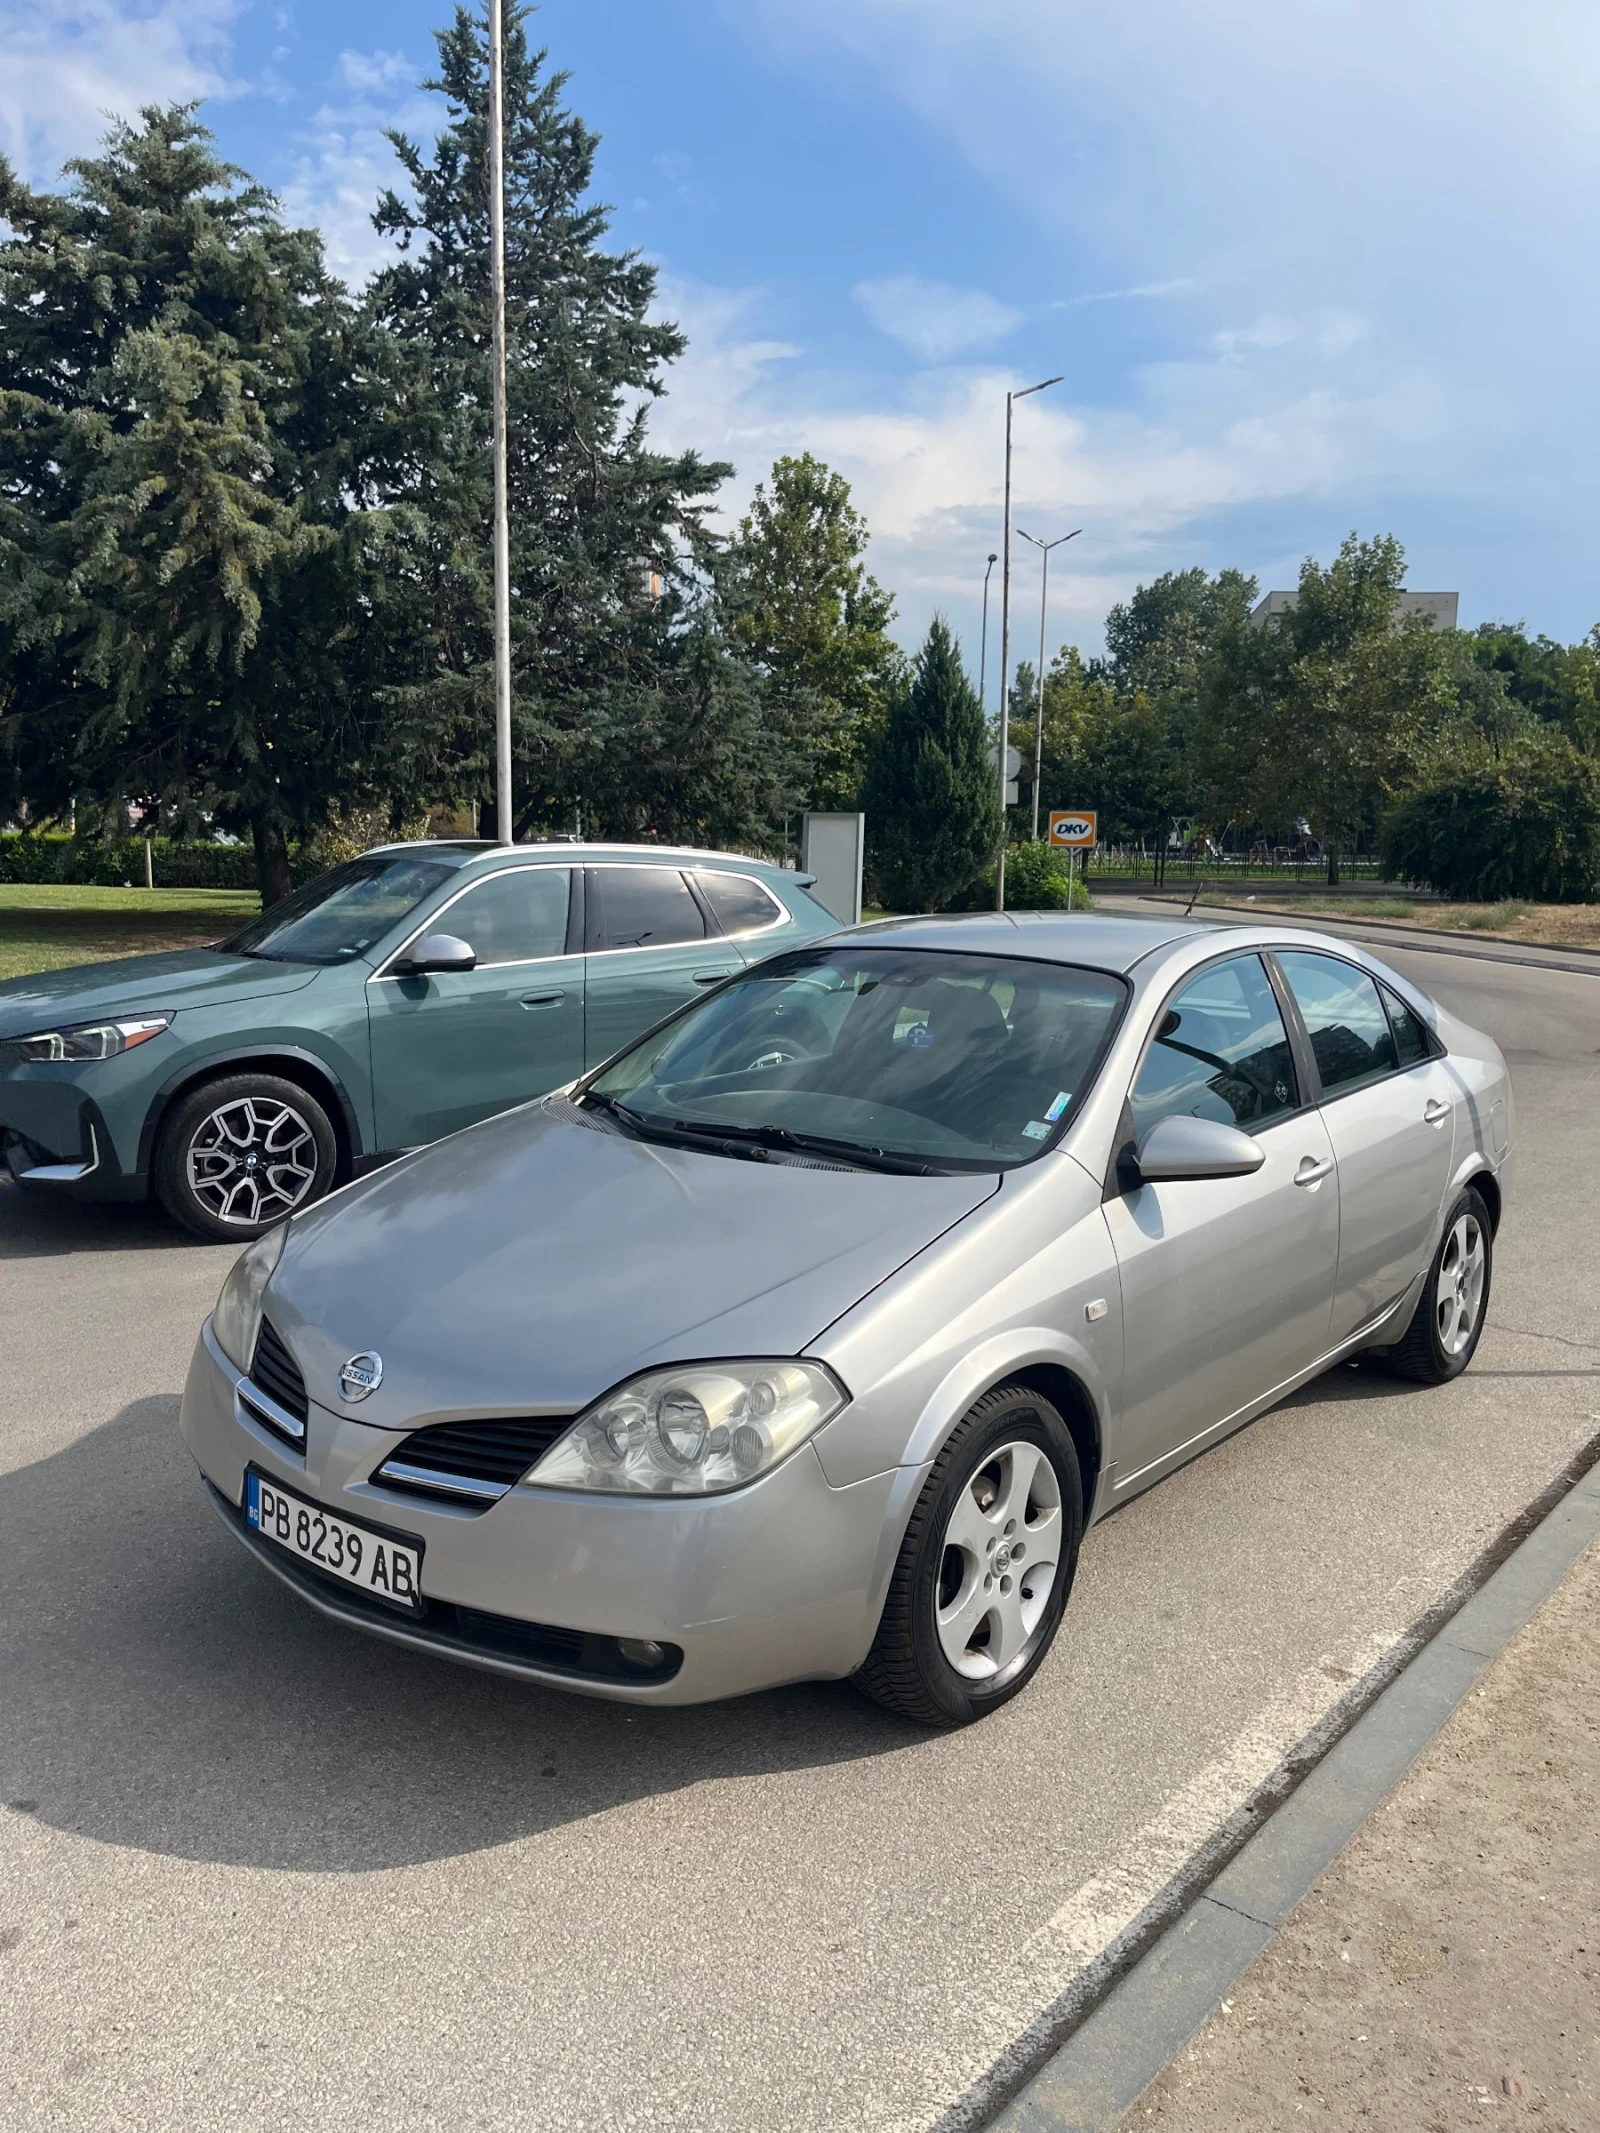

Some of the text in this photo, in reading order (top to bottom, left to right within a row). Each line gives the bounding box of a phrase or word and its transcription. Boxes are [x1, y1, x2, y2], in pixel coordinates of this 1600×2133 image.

[1056, 823, 1089, 834] DKV
[249, 1505, 258, 1520] BG
[261, 1487, 412, 1597] PB 8239 AB
